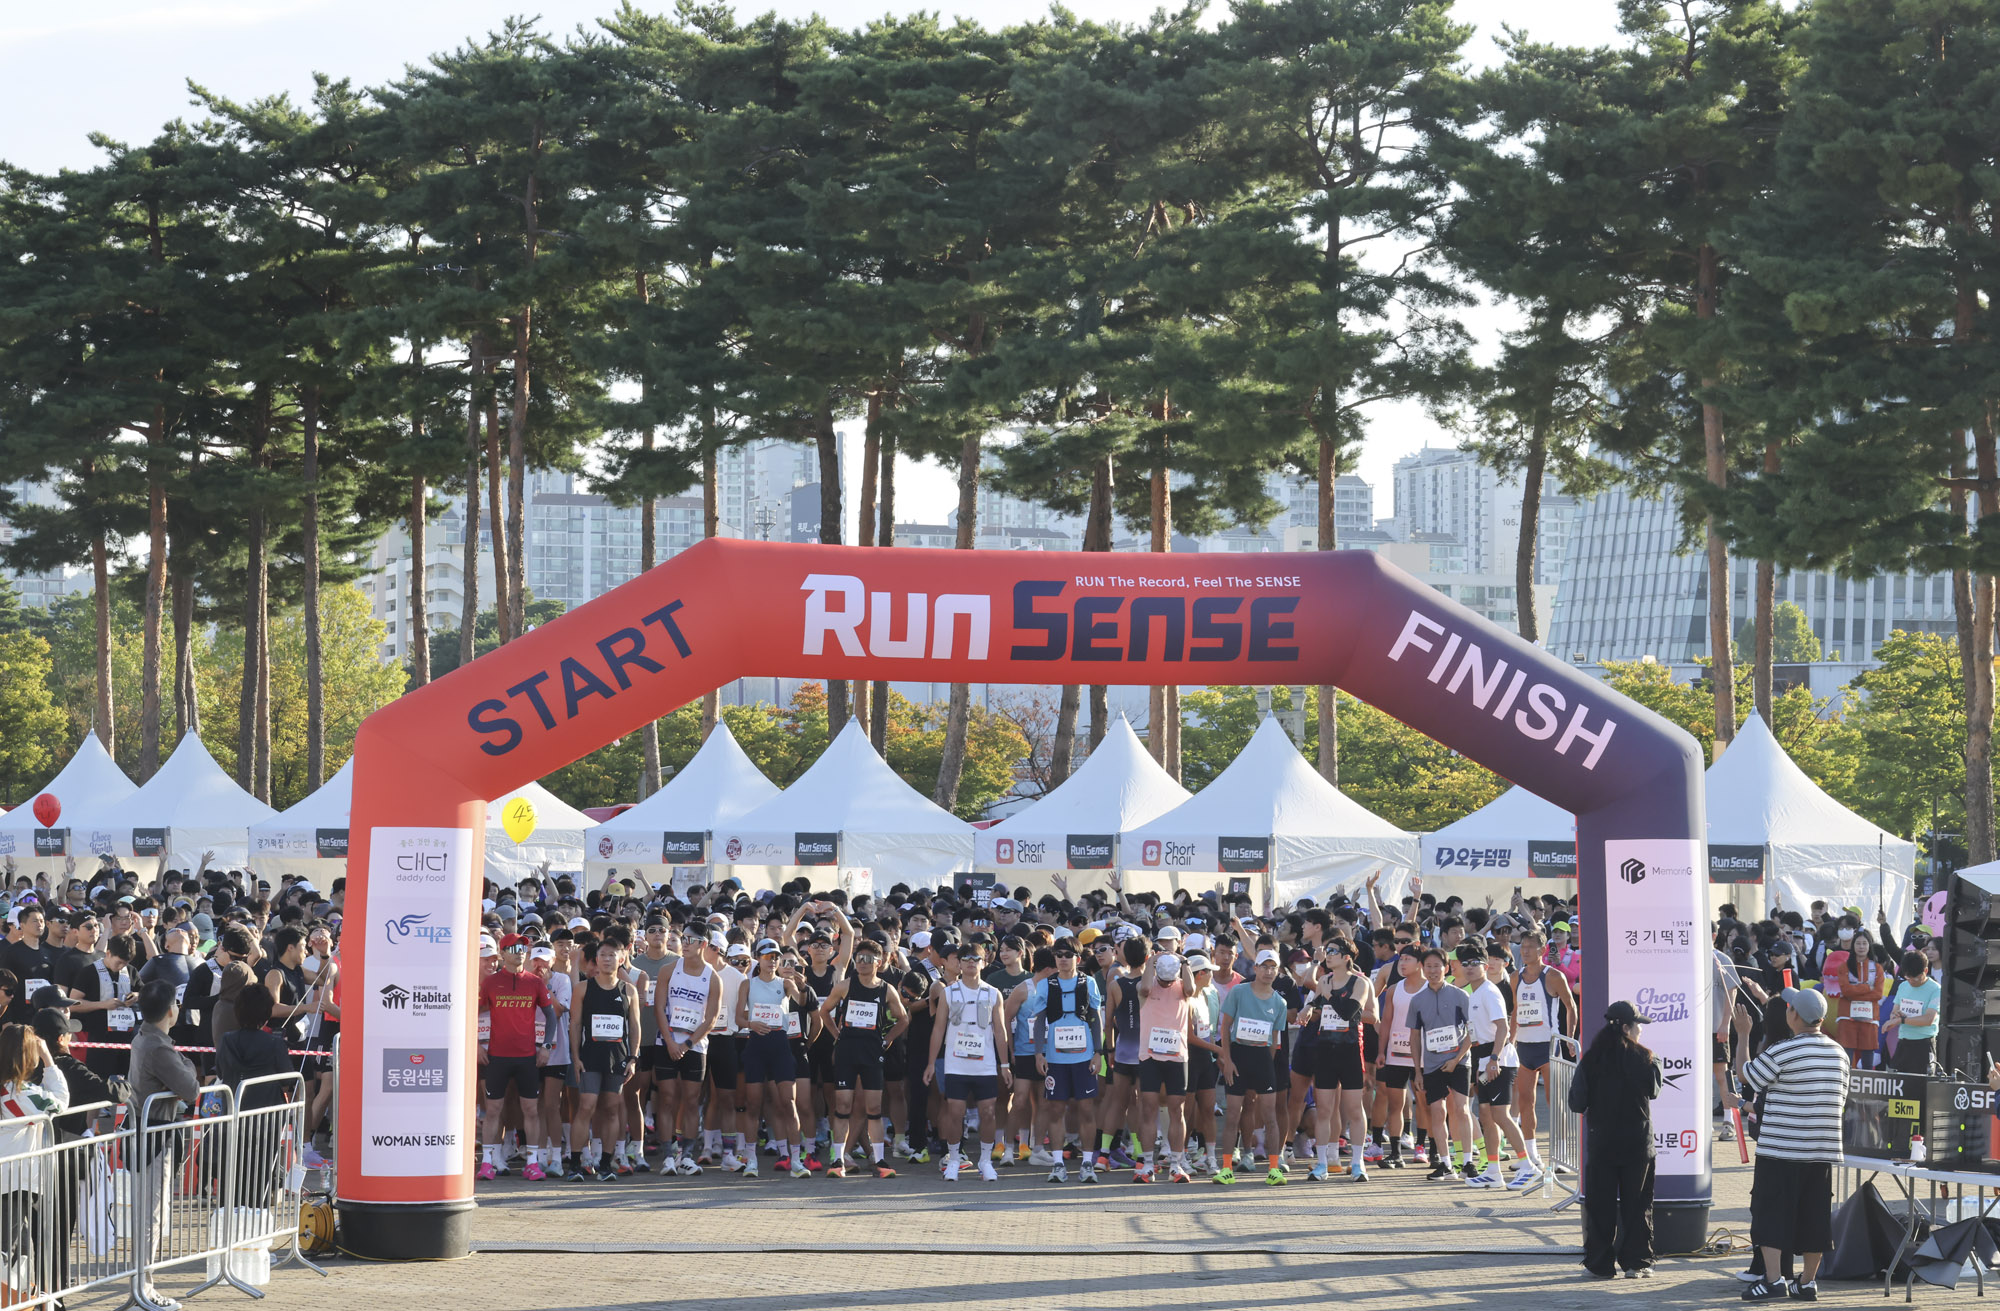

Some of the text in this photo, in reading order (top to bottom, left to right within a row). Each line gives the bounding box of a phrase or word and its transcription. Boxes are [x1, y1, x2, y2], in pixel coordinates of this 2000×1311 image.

[1075, 576, 1301, 590] RUN The Record, Feel The SENSE
[467, 598, 694, 757] START
[1387, 609, 1617, 771] FINISH
[0, 831, 15, 841] hoco
[0, 841, 16, 855] ealth
[1017, 839, 1046, 854] Short
[1165, 841, 1196, 856] Short
[396, 874, 446, 883] daddy food
[414, 926, 452, 943] 피죤
[412, 991, 452, 1003] Habitat
[1636, 987, 1686, 1005] Choco
[423, 1003, 451, 1011] Humanity
[855, 1010, 874, 1018] 1095
[964, 1040, 982, 1048] 1234
[387, 1068, 444, 1087] 동원샘물
[1850, 1075, 1904, 1097] SAMIK
[1894, 1102, 1914, 1116] 5km
[371, 1134, 456, 1147] WOMAN SENSE
